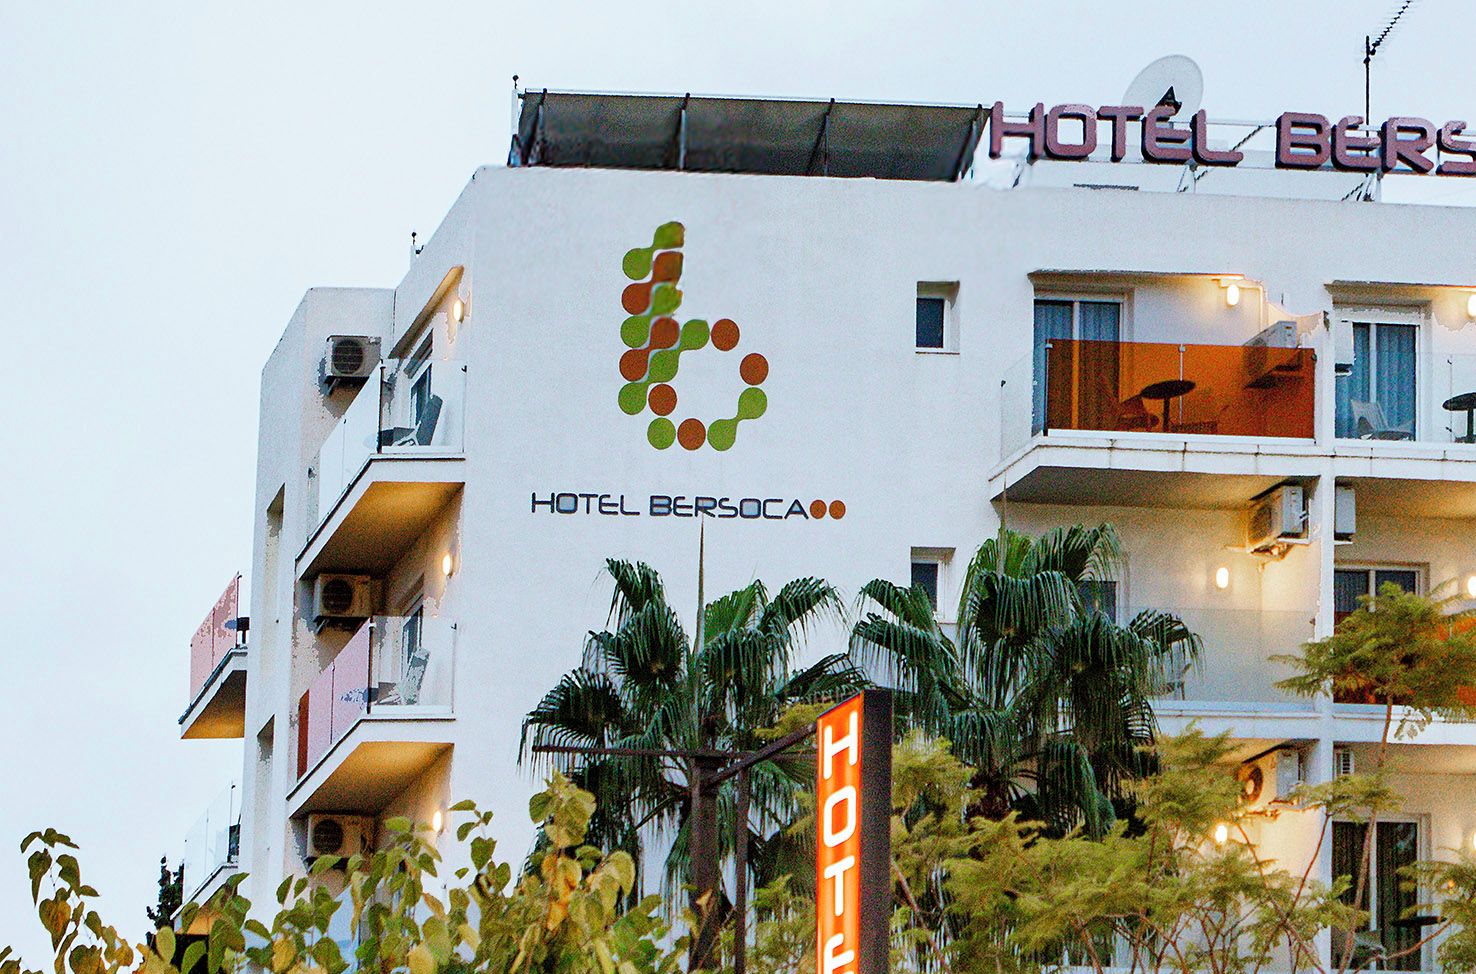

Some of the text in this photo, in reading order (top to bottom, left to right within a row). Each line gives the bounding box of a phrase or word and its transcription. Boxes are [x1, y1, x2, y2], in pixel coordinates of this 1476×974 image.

[989, 101, 1244, 167] HOTEL
[531, 492, 809, 520] HOTEL BERSOCA
